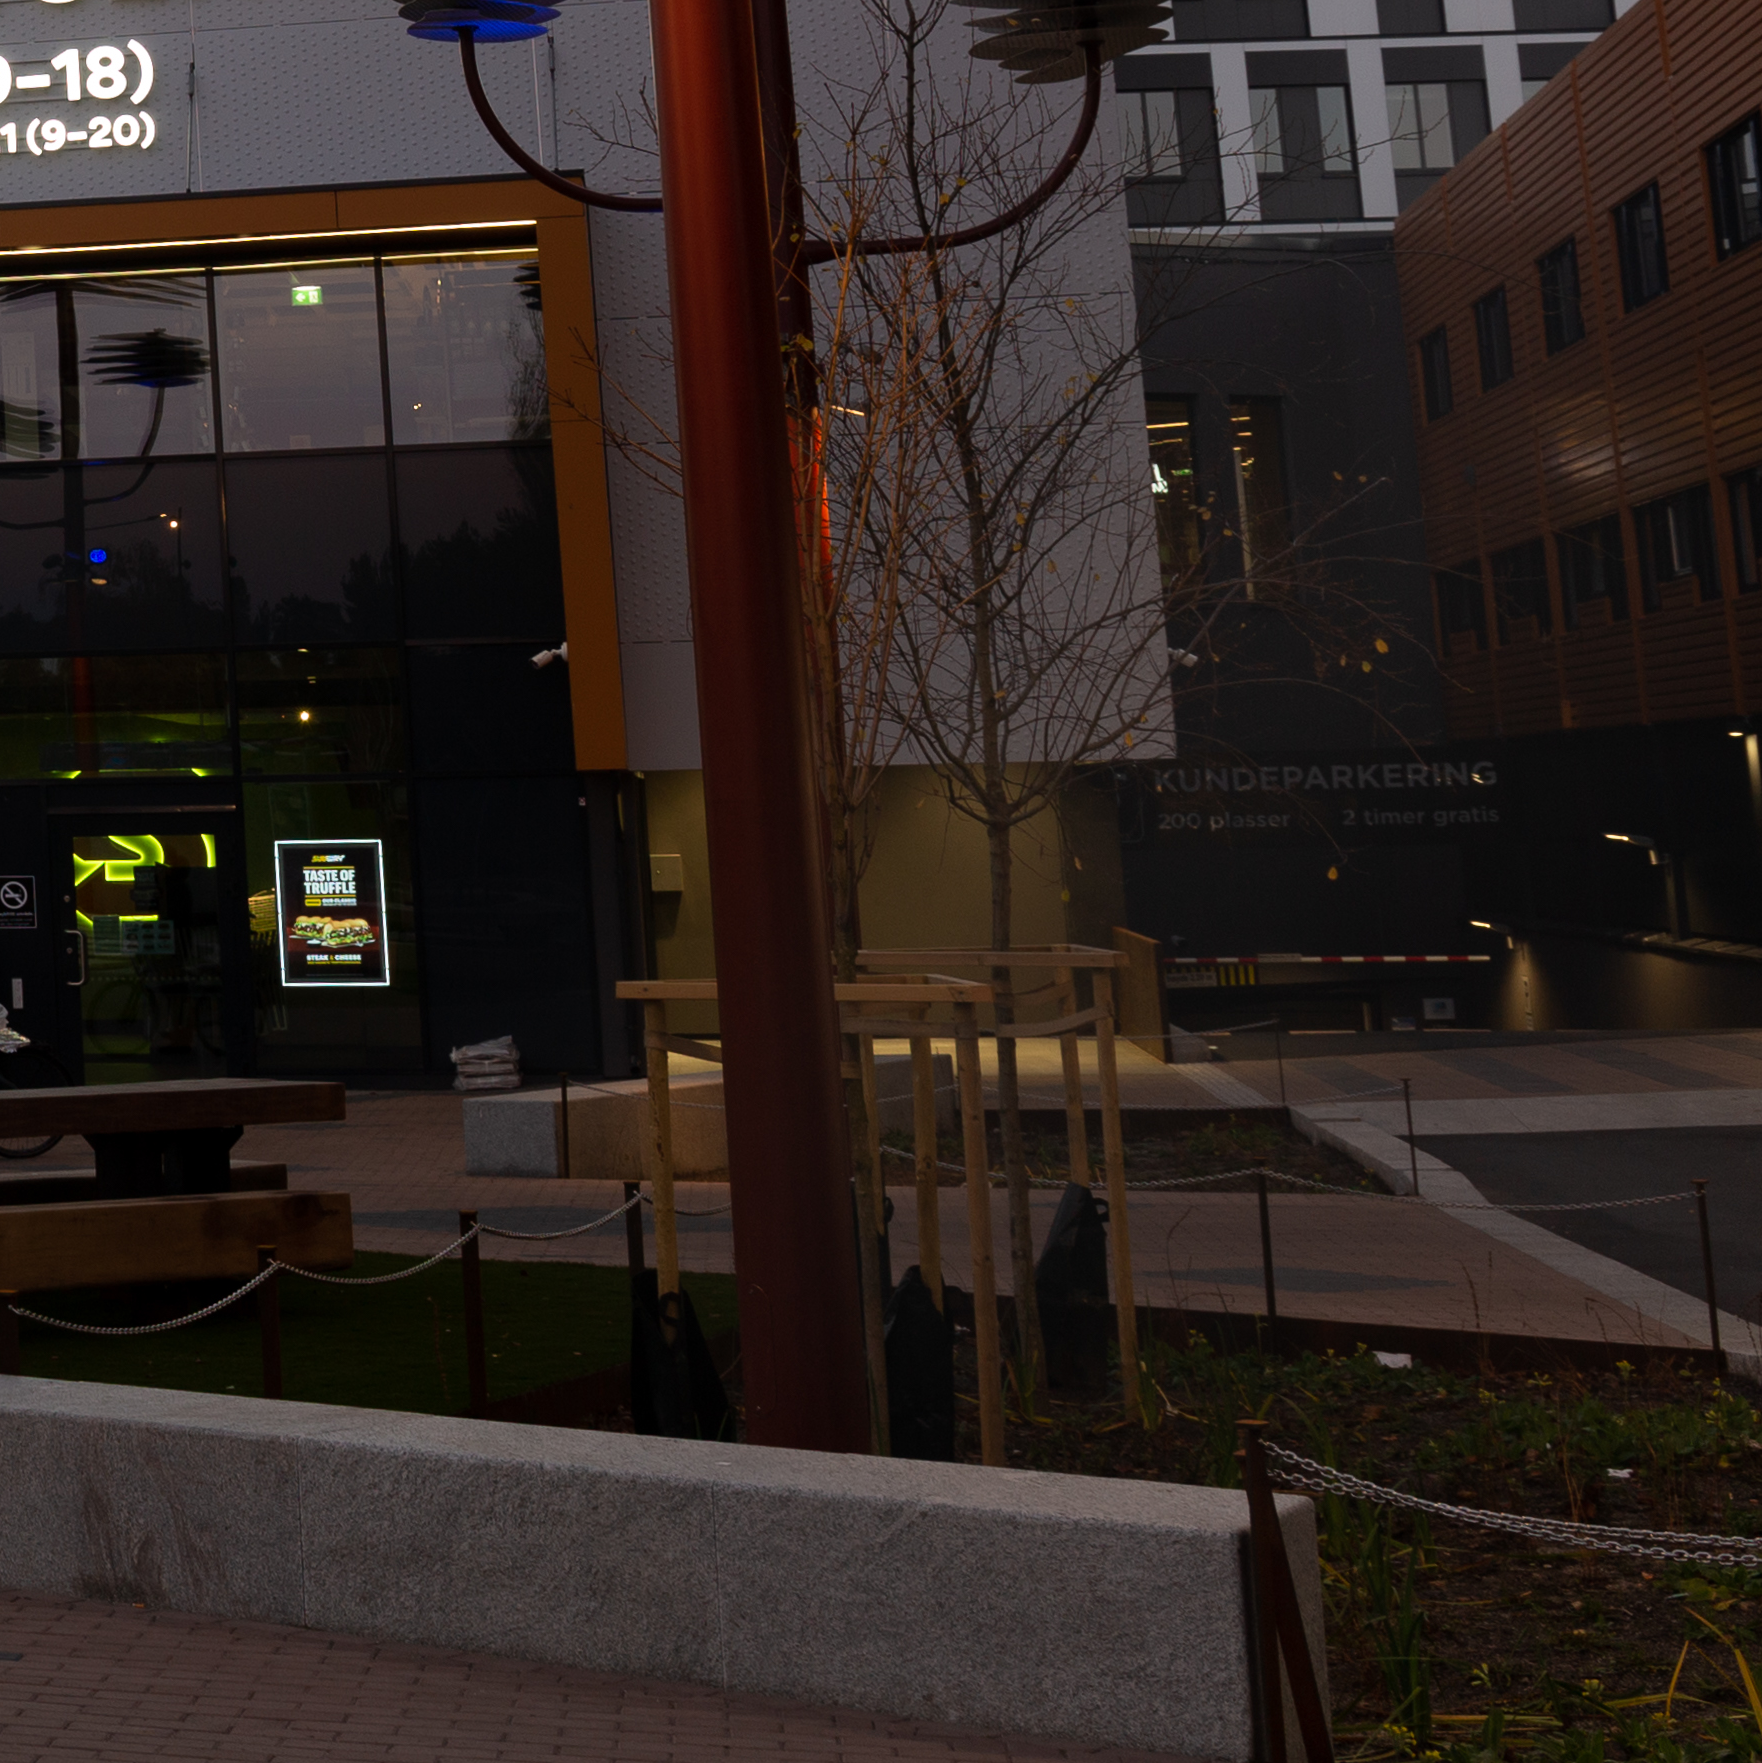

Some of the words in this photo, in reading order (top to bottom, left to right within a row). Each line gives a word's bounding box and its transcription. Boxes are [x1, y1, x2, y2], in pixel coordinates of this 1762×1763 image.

[1154, 761, 1497, 793] KUNDEPARKERING
[1158, 813, 1201, 830] 200
[1210, 812, 1291, 833] plasser
[1342, 809, 1357, 826] 2
[1364, 807, 1426, 826] timer
[1433, 805, 1500, 828] gratis
[303, 870, 339, 882] TASTE
[340, 870, 355, 881] OF
[304, 882, 356, 894] TRUFFLE
